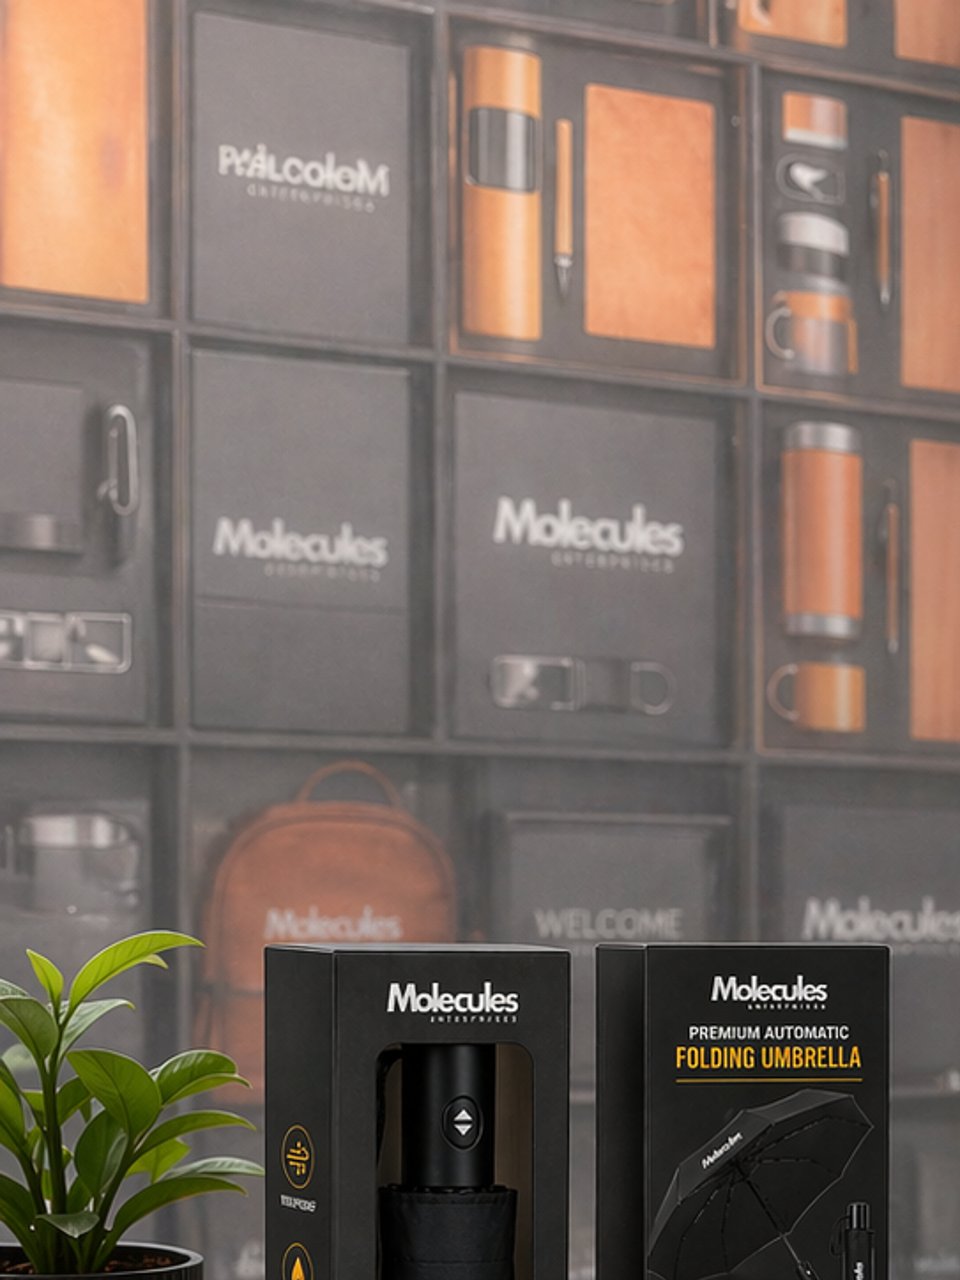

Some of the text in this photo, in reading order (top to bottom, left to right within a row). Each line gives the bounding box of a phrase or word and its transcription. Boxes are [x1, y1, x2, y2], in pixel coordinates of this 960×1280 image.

[213, 516, 389, 568] Molecules
[493, 496, 684, 557] Molecules
[264, 904, 403, 940] Molecules
[534, 907, 684, 939] WELCOME
[387, 982, 519, 1013] Molecules
[711, 975, 828, 1001] Molecules
[689, 1025, 849, 1040] PREMIUM AUTOMATIC
[676, 1046, 862, 1068] FOLDING UMBRELLA
